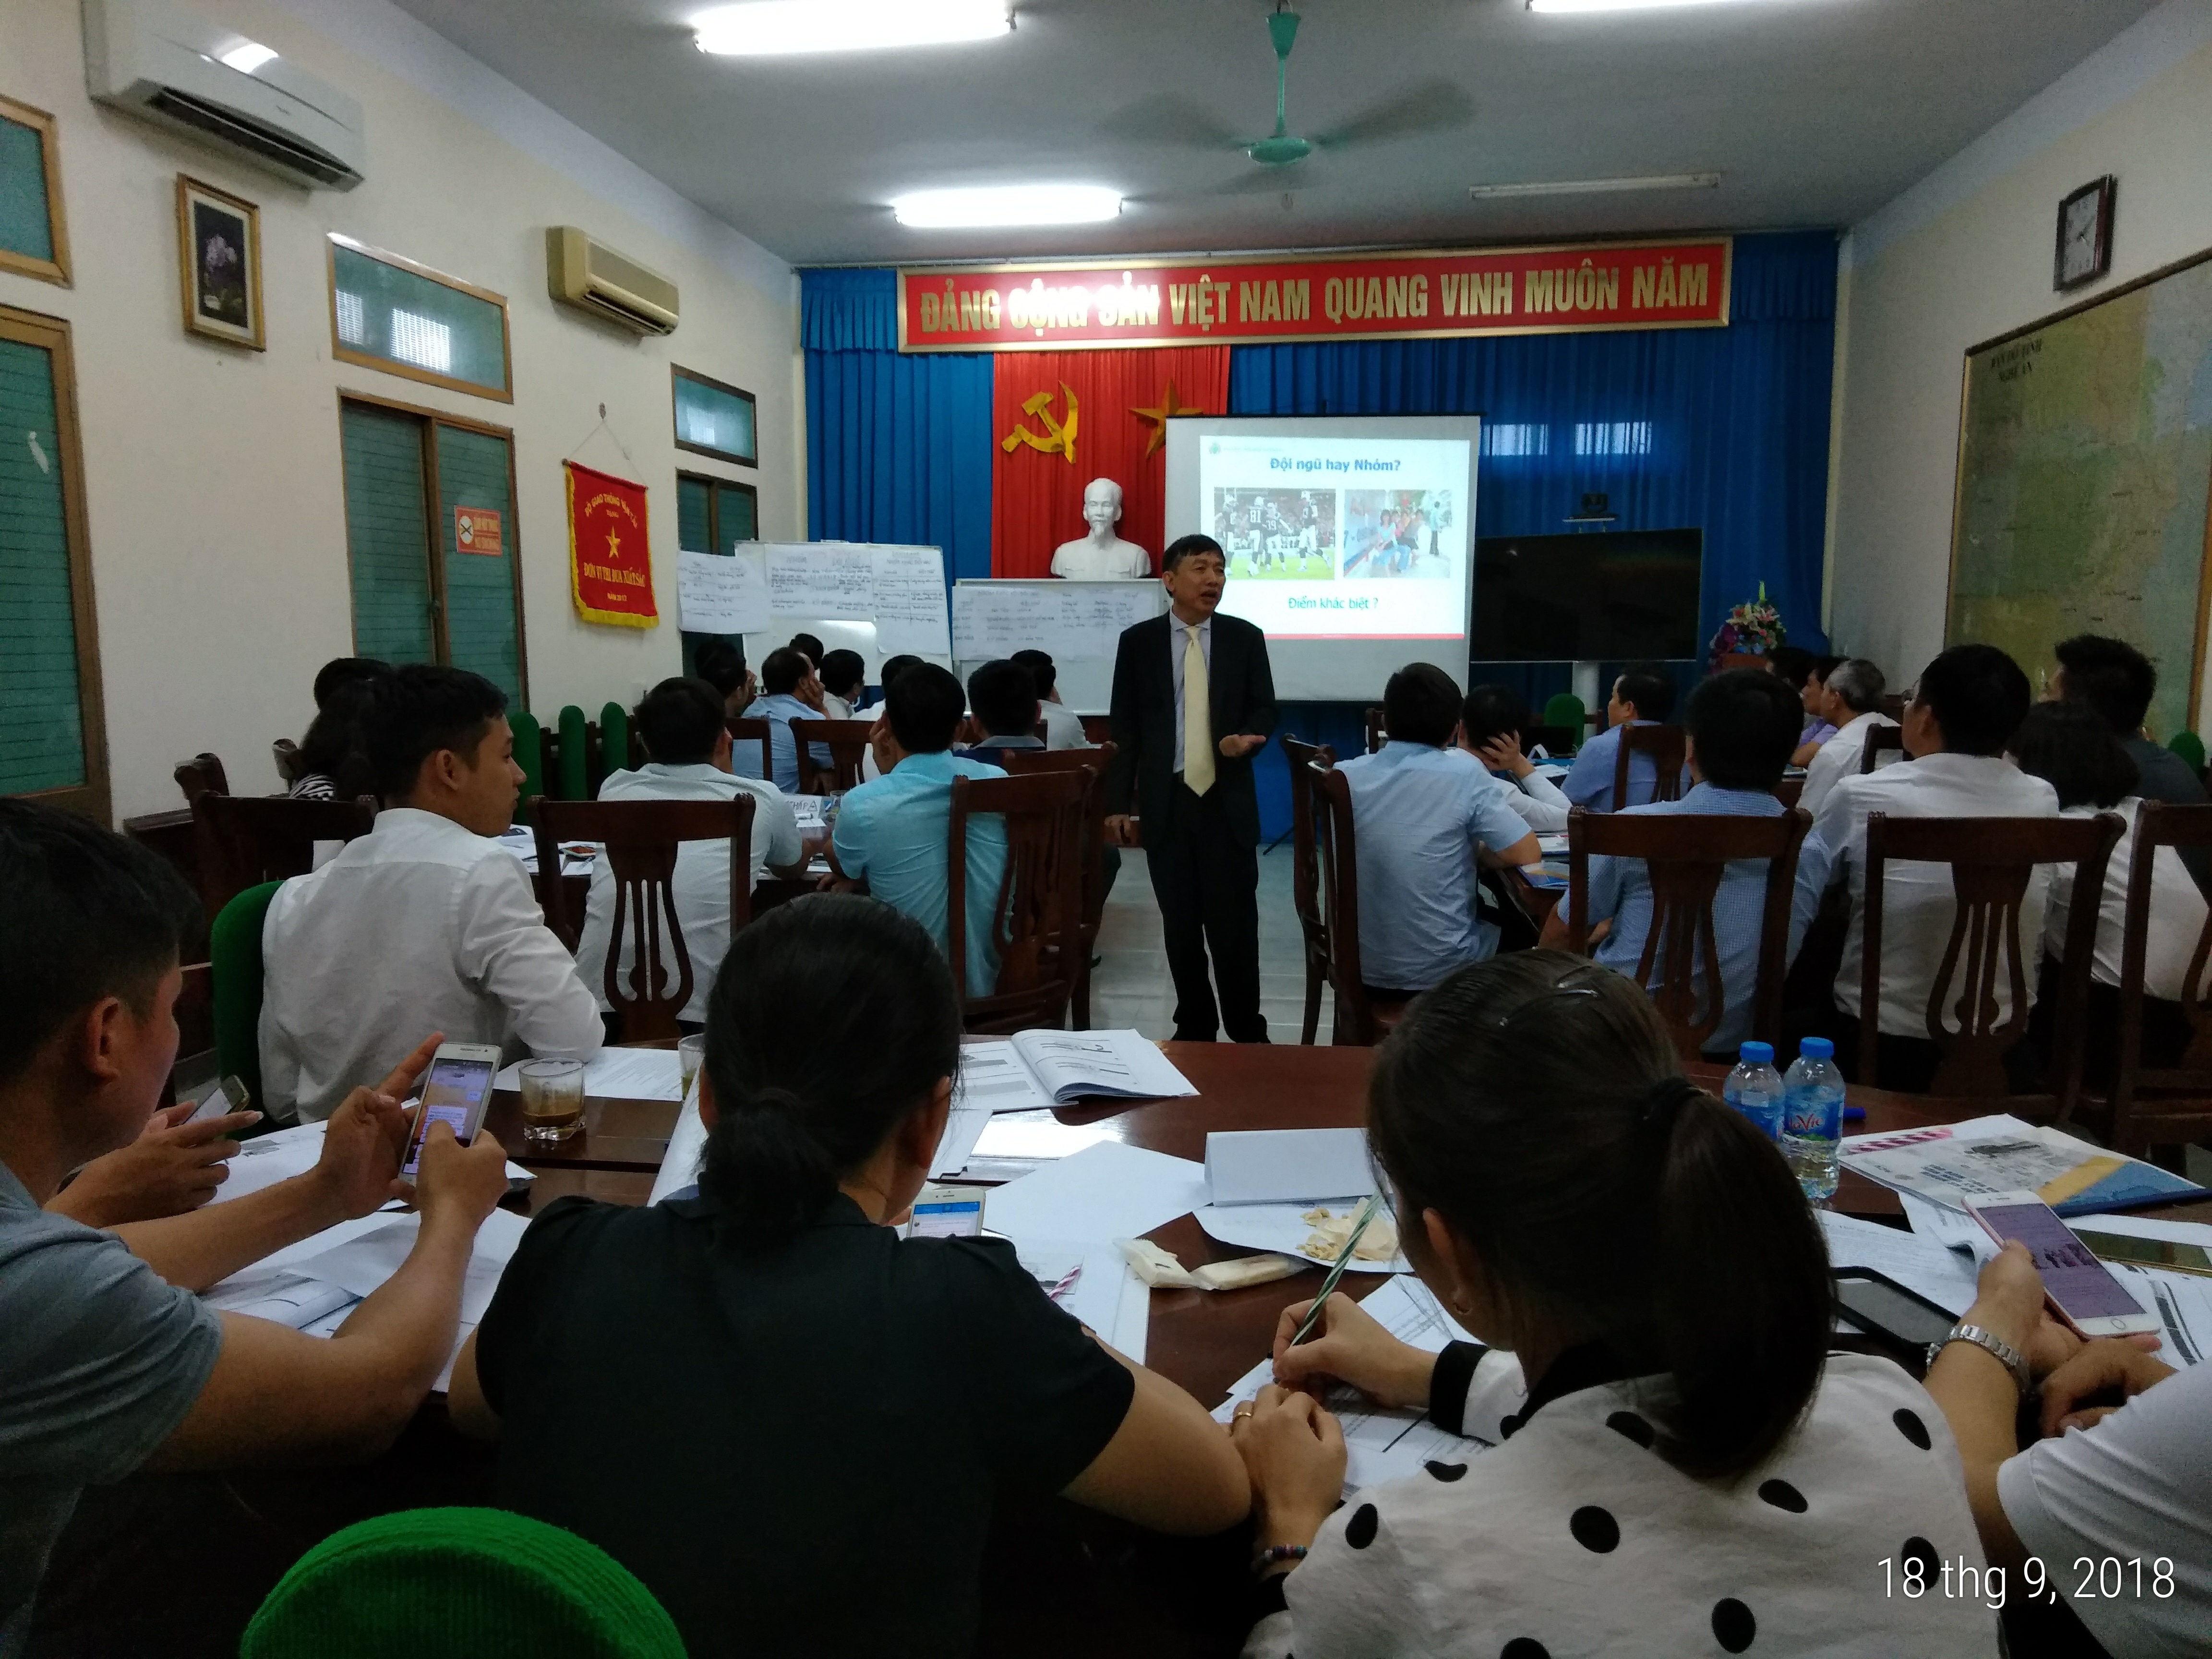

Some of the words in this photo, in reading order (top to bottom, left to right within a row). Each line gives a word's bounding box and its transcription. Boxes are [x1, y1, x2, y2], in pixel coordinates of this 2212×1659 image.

[921, 278, 1001, 332] ĐẢNG
[1098, 271, 1160, 326] SẢN
[1169, 274, 1230, 331] VIỆT
[1239, 278, 1310, 322] NAM
[1325, 274, 1428, 324] QUANG
[1441, 272, 1513, 317] VINH
[1524, 258, 1619, 313] MUÔN
[1633, 256, 1708, 309] NĂM
[1296, 457, 1322, 472] ngũ
[1326, 458, 1350, 472] hay
[1354, 458, 1401, 471] Nhóm?
[1288, 595, 1317, 609] Điểm
[1320, 597, 1345, 609] khác
[1349, 597, 1369, 611] biệt
